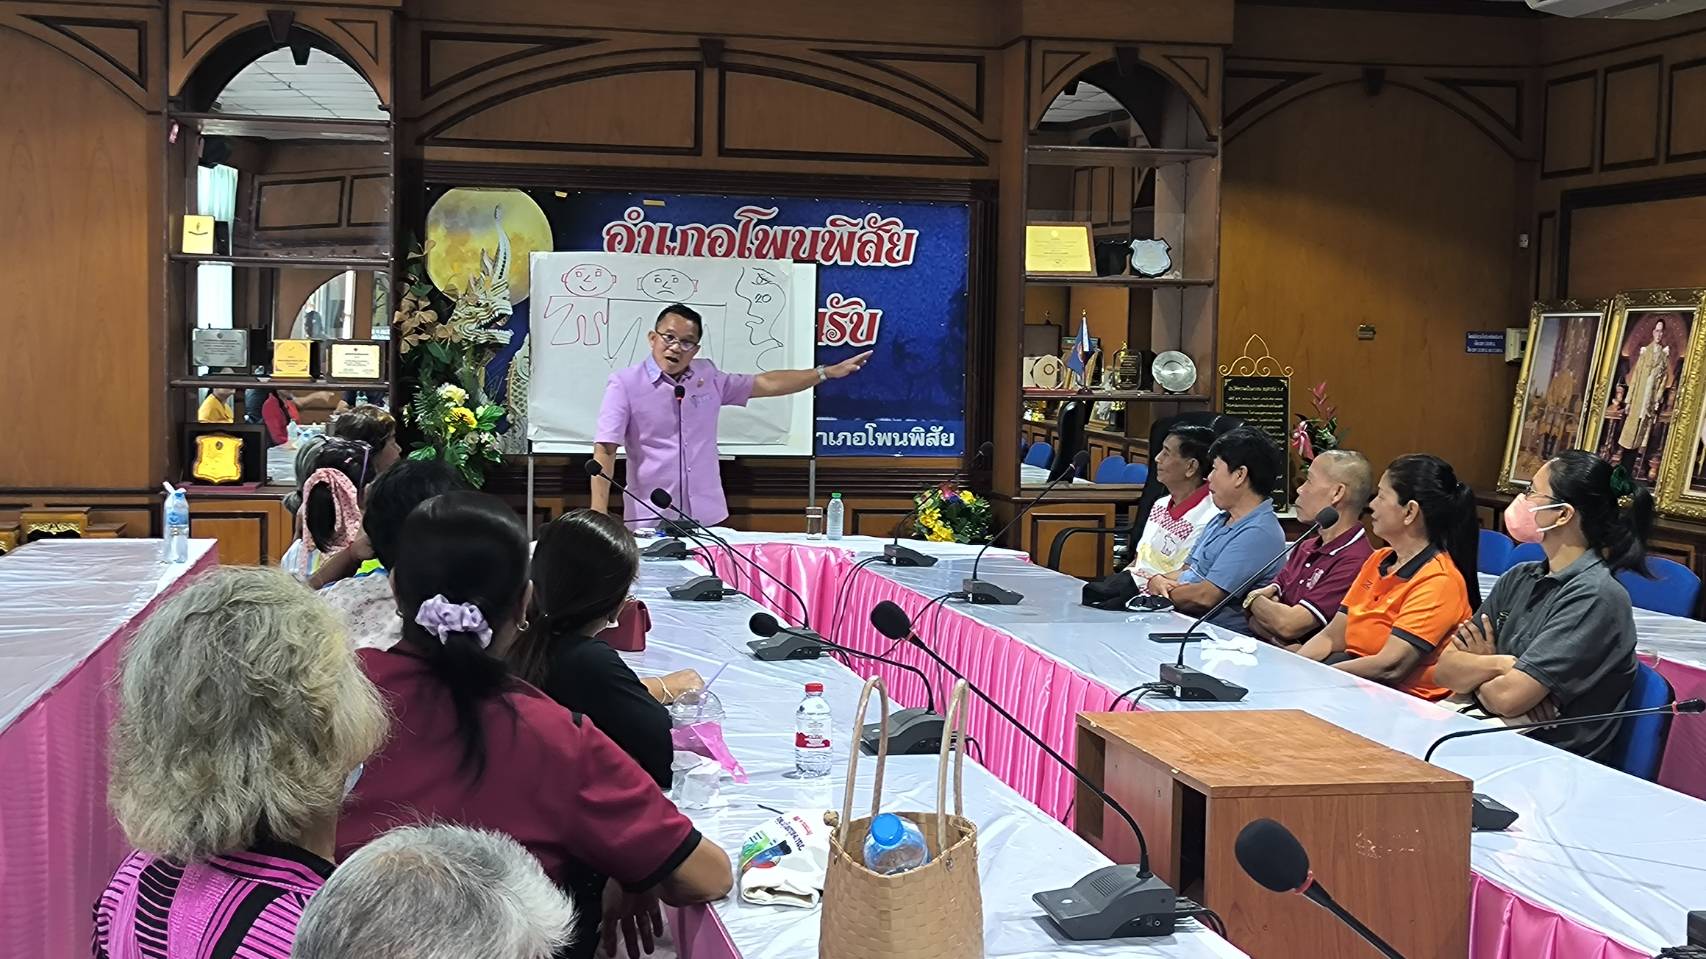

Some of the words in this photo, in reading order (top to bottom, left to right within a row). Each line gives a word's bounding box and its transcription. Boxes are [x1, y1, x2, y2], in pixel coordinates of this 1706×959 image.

[602, 206, 919, 266] อำเภอโพนพิสัย
[755, 293, 772, 304] 20
